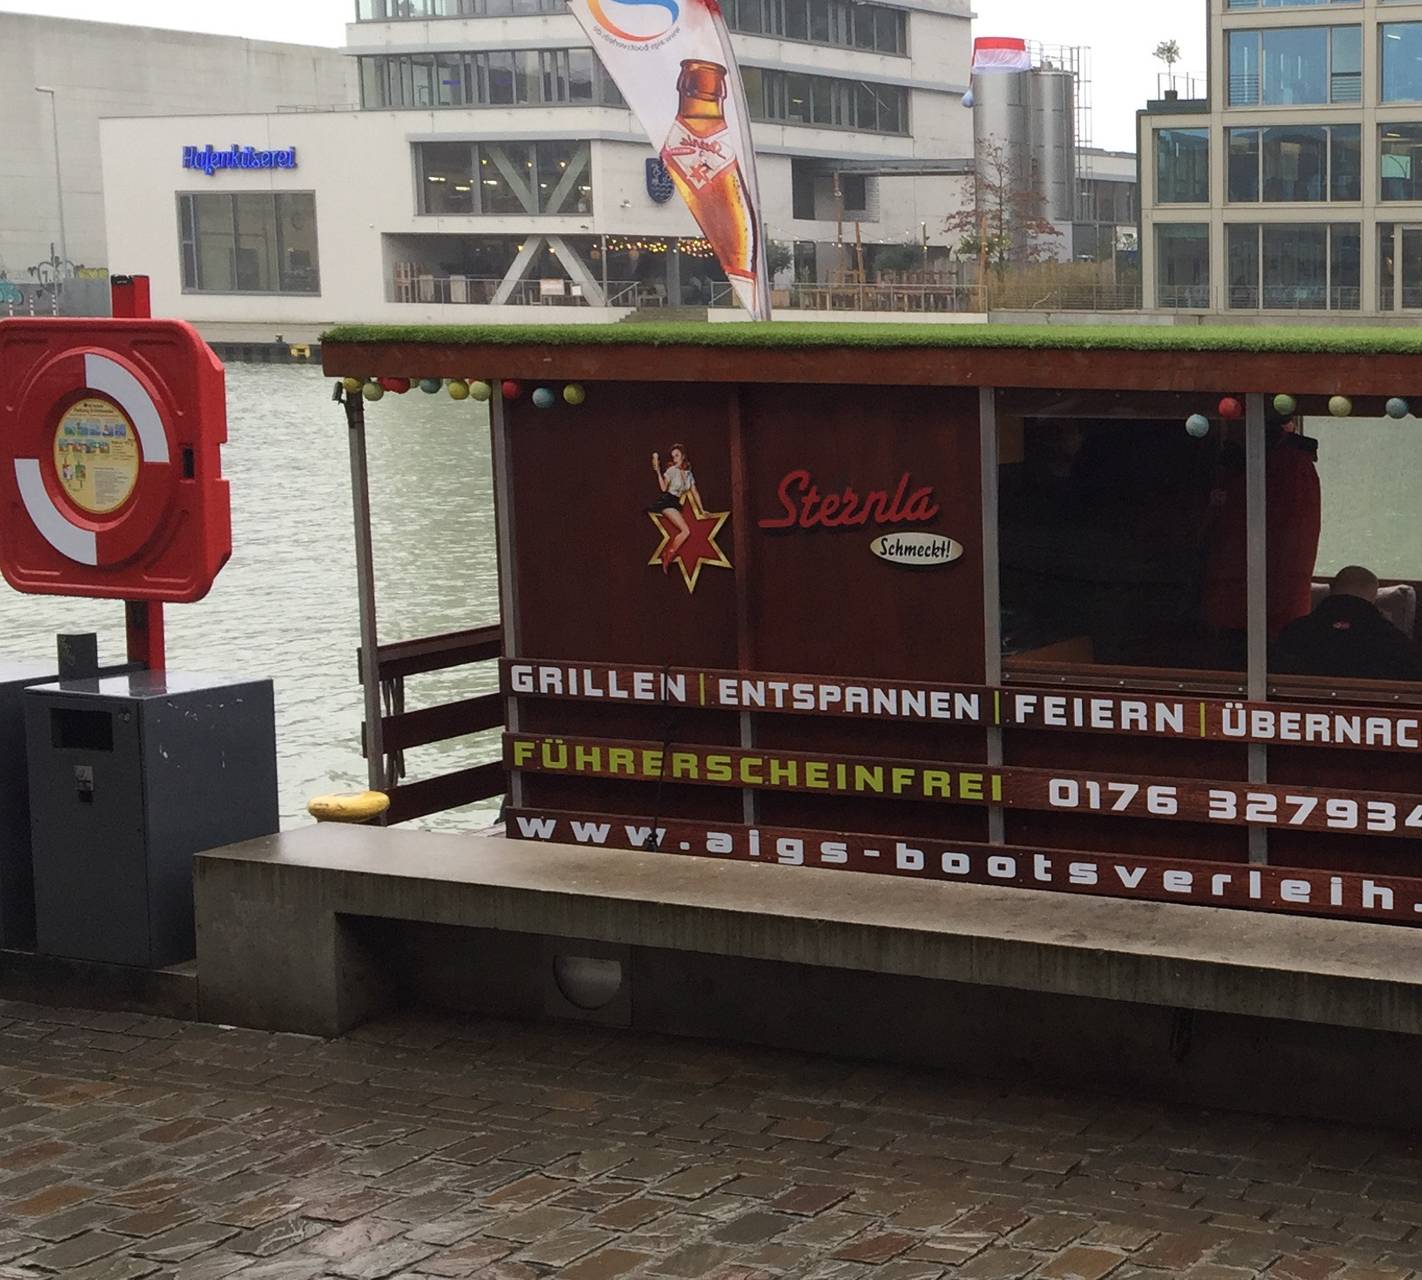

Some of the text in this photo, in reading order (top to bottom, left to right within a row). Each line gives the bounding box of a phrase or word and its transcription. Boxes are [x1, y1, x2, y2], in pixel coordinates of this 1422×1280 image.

[758, 469, 939, 528] Sternla
[879, 537, 950, 558] Schmeckt!
[511, 665, 687, 702] GRILLEN
[719, 679, 979, 721] ENTSPANNEN
[1015, 694, 1184, 733] FEIERN
[513, 738, 1001, 802] FÜHRERSCHEINFREI
[1049, 778, 1178, 816] 0176
